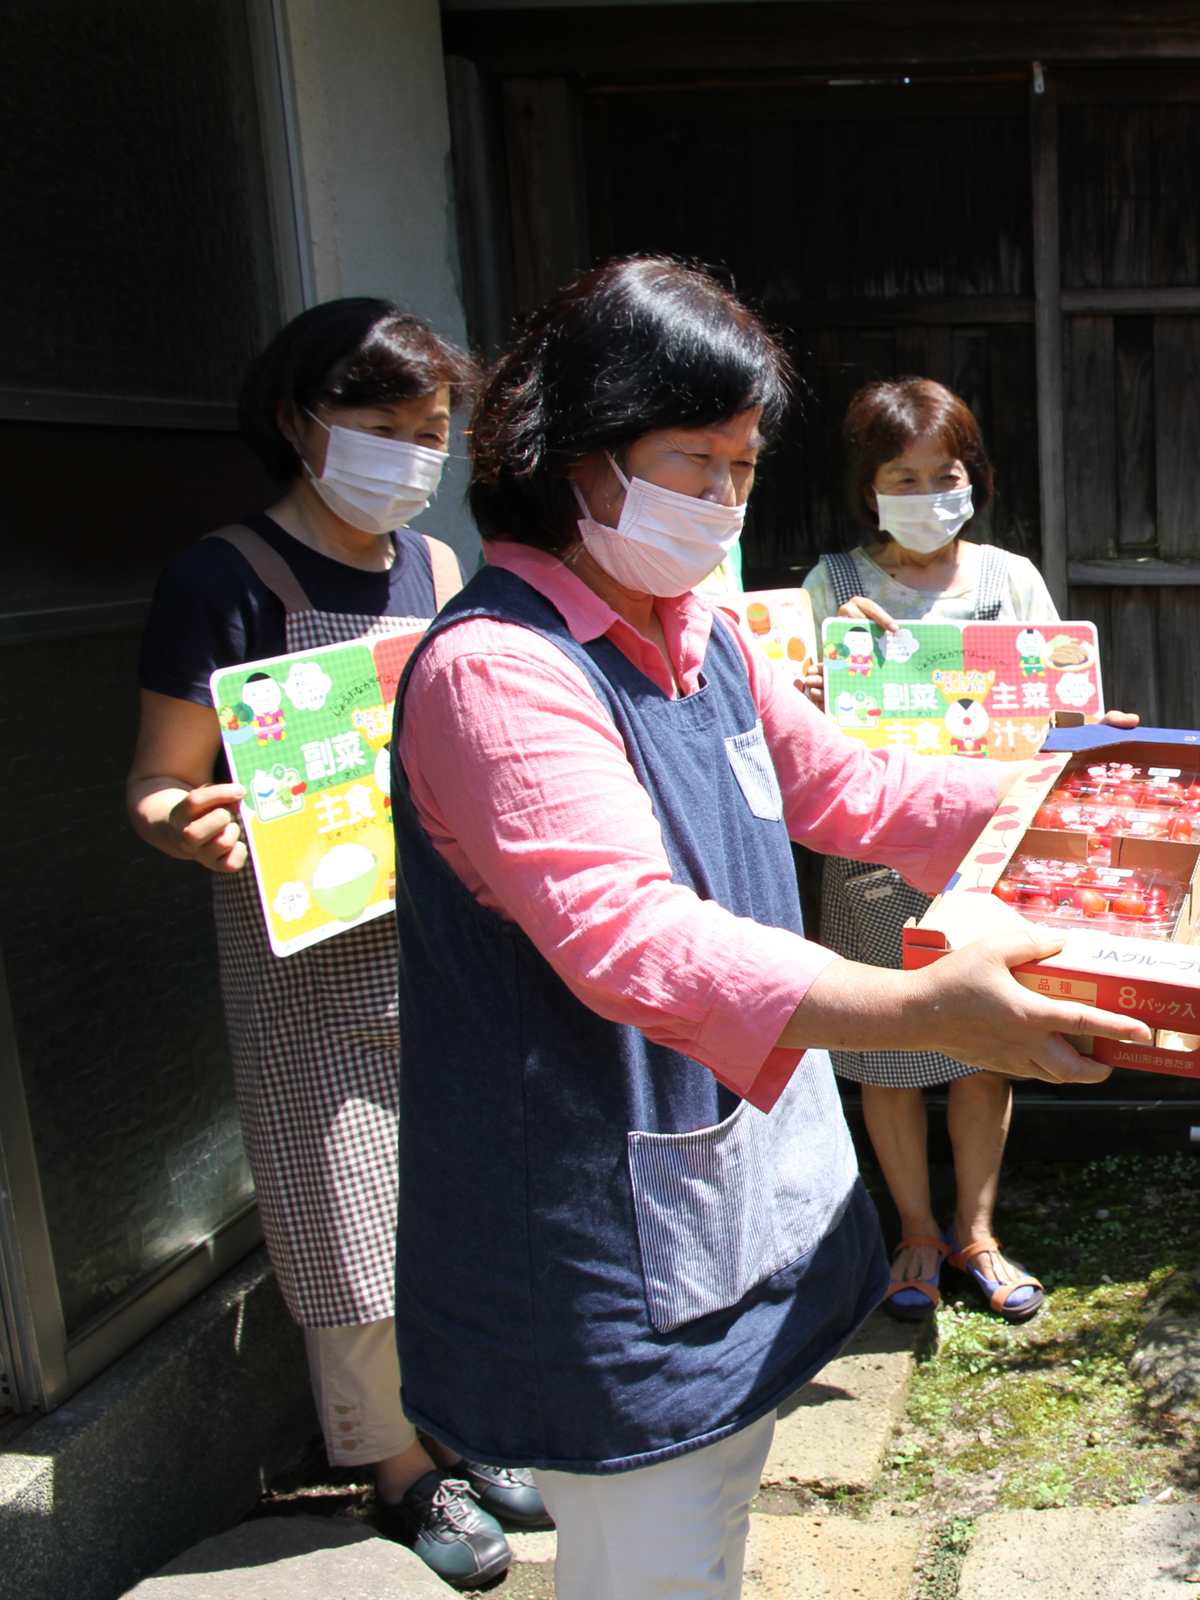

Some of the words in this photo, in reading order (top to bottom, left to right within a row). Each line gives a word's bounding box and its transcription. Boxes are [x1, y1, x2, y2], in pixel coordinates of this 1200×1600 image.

[882, 682, 939, 711] 副菜
[991, 681, 1050, 709] 主菜
[885, 721, 943, 750] 主食
[300, 730, 366, 781] 副菜
[314, 783, 376, 834] 主食
[1038, 978, 1072, 995] 品種
[1118, 985, 1196, 1019] 8パック入
[1113, 1051, 1194, 1069] JA山形おきたま
